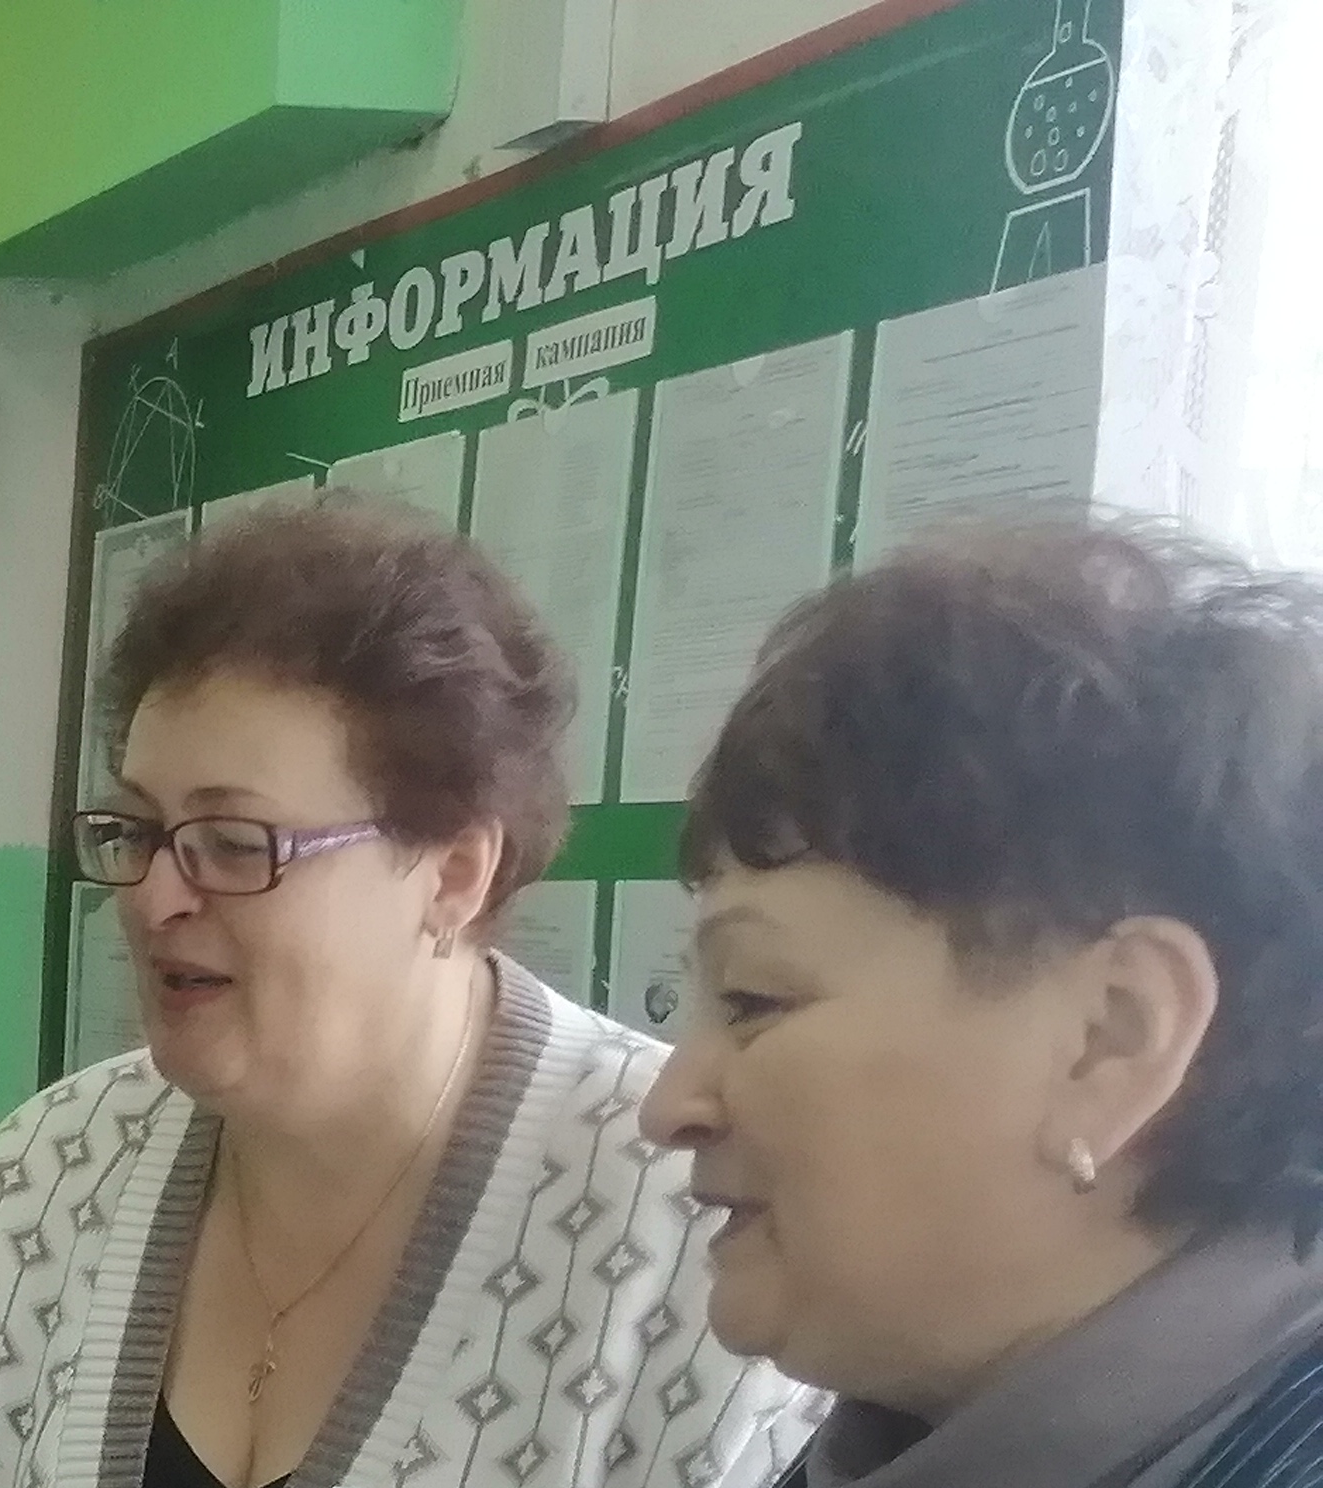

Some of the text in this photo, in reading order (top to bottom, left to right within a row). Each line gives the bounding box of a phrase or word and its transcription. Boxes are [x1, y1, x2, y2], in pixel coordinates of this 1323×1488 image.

[245, 121, 803, 399] ИНФОРМАЦИЯ
[402, 316, 648, 415] Приемная кампания
